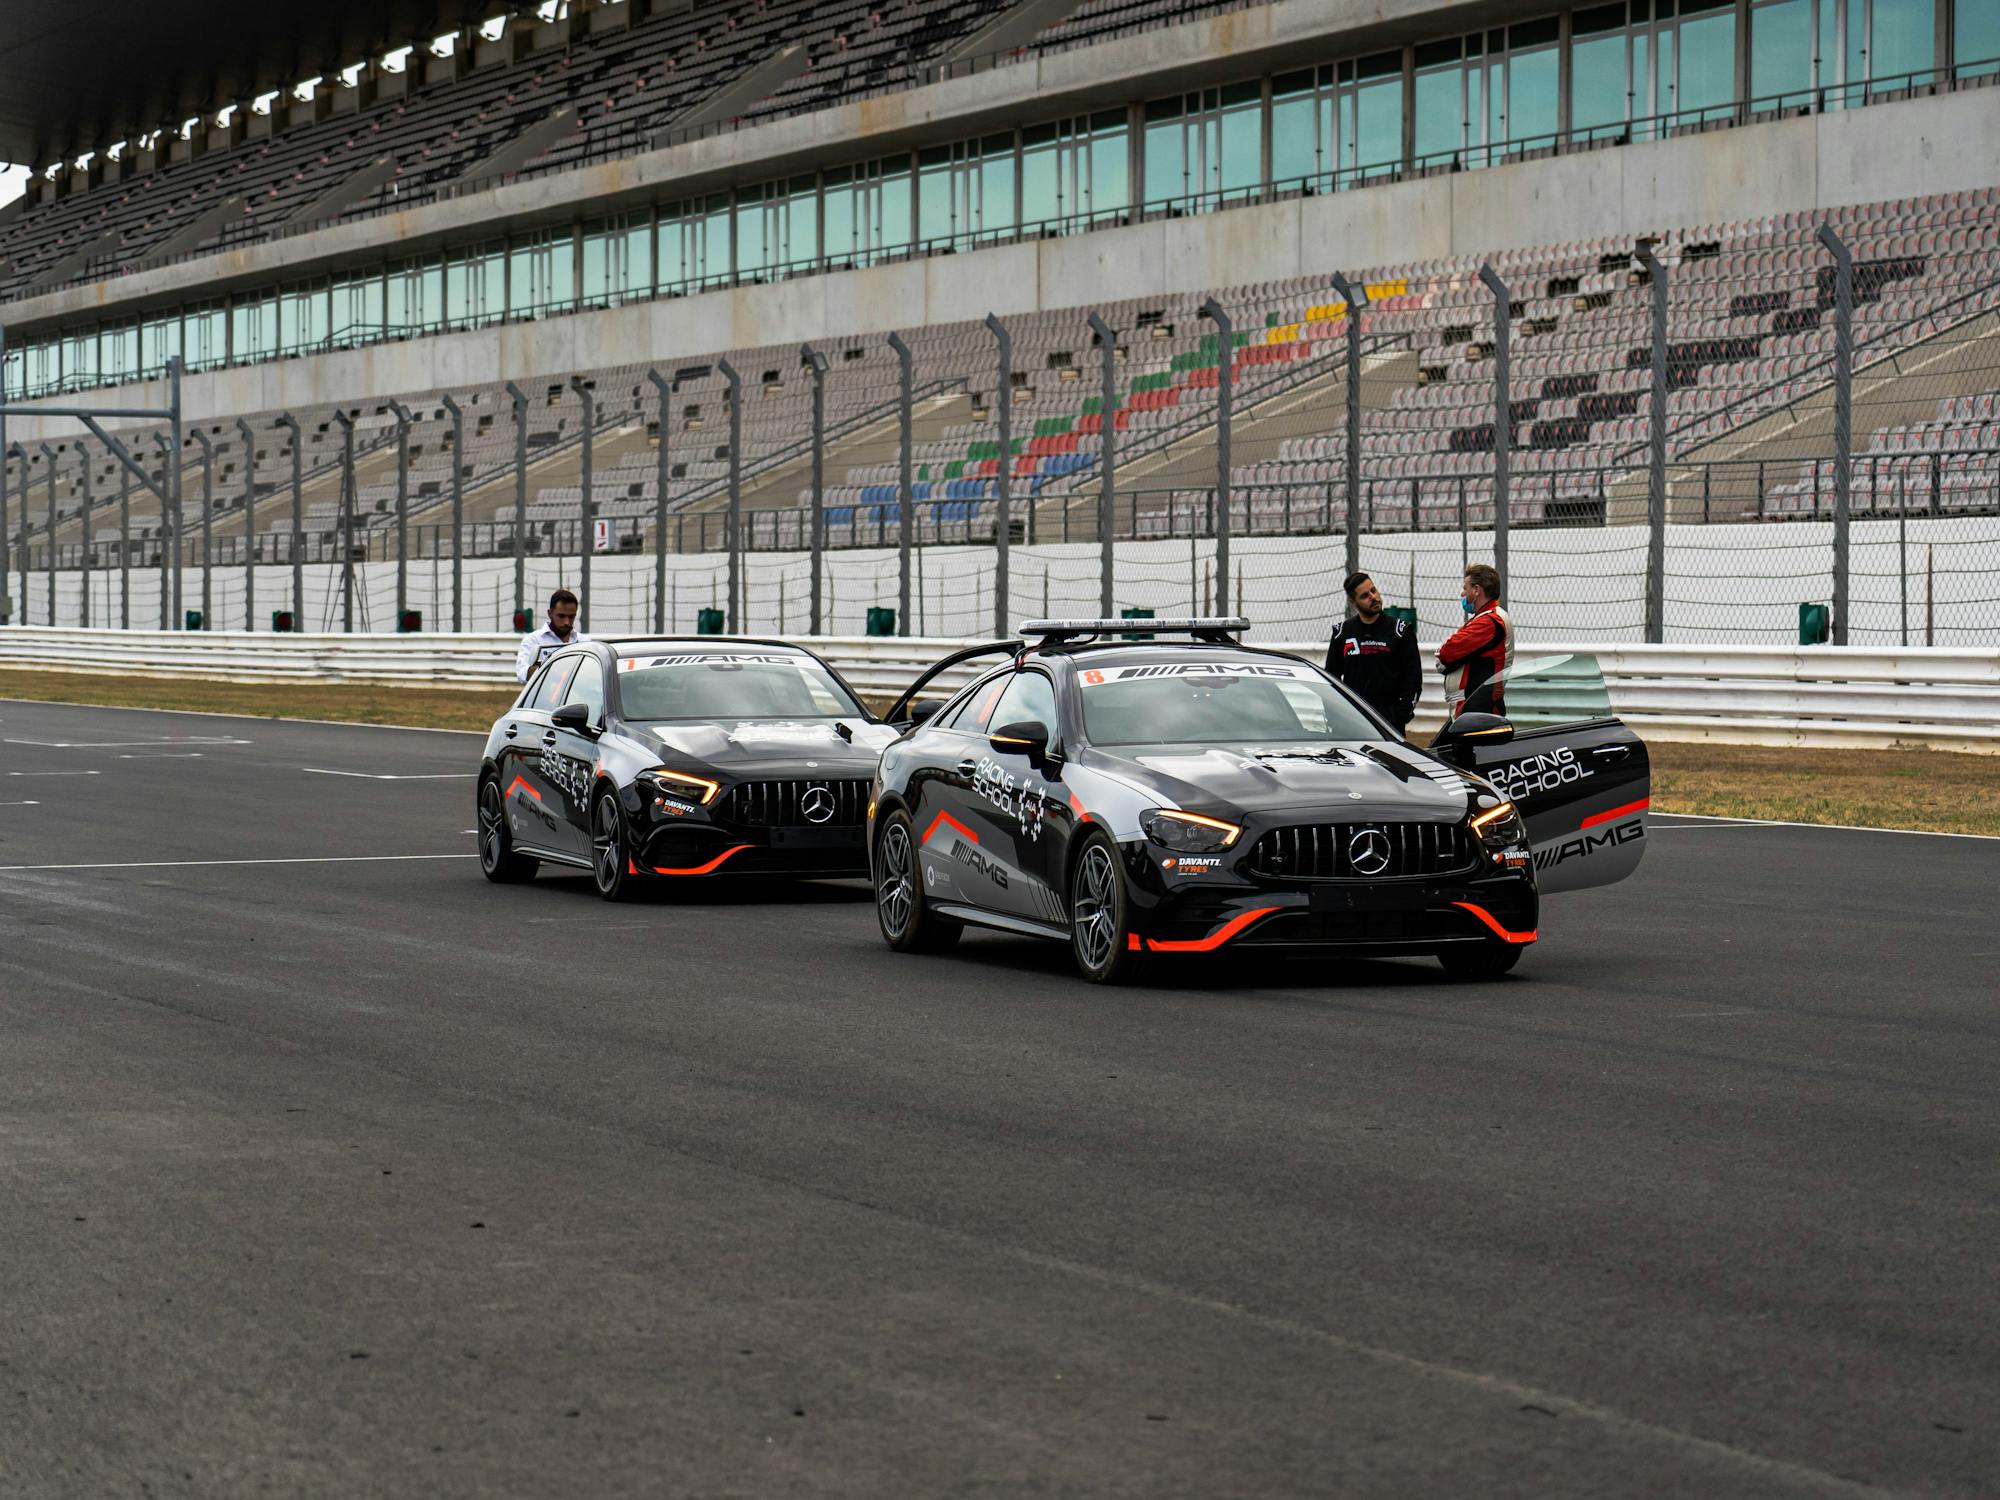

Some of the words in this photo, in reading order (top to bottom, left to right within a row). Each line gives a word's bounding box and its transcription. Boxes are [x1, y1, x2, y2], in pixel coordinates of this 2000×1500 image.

[624, 659, 635, 670] 1
[697, 655, 796, 664] AMG
[1084, 669, 1105, 685] 8
[1175, 665, 1296, 677] AMG
[540, 757, 571, 793] SCHOOL
[976, 757, 1015, 793] RACING
[1488, 746, 1575, 785] RACING
[972, 774, 1016, 818] SCHOOL
[529, 801, 557, 832] AMG
[1556, 819, 1644, 865] AMG
[966, 849, 1009, 890] AMG
[1178, 865, 1208, 873] TYRES
